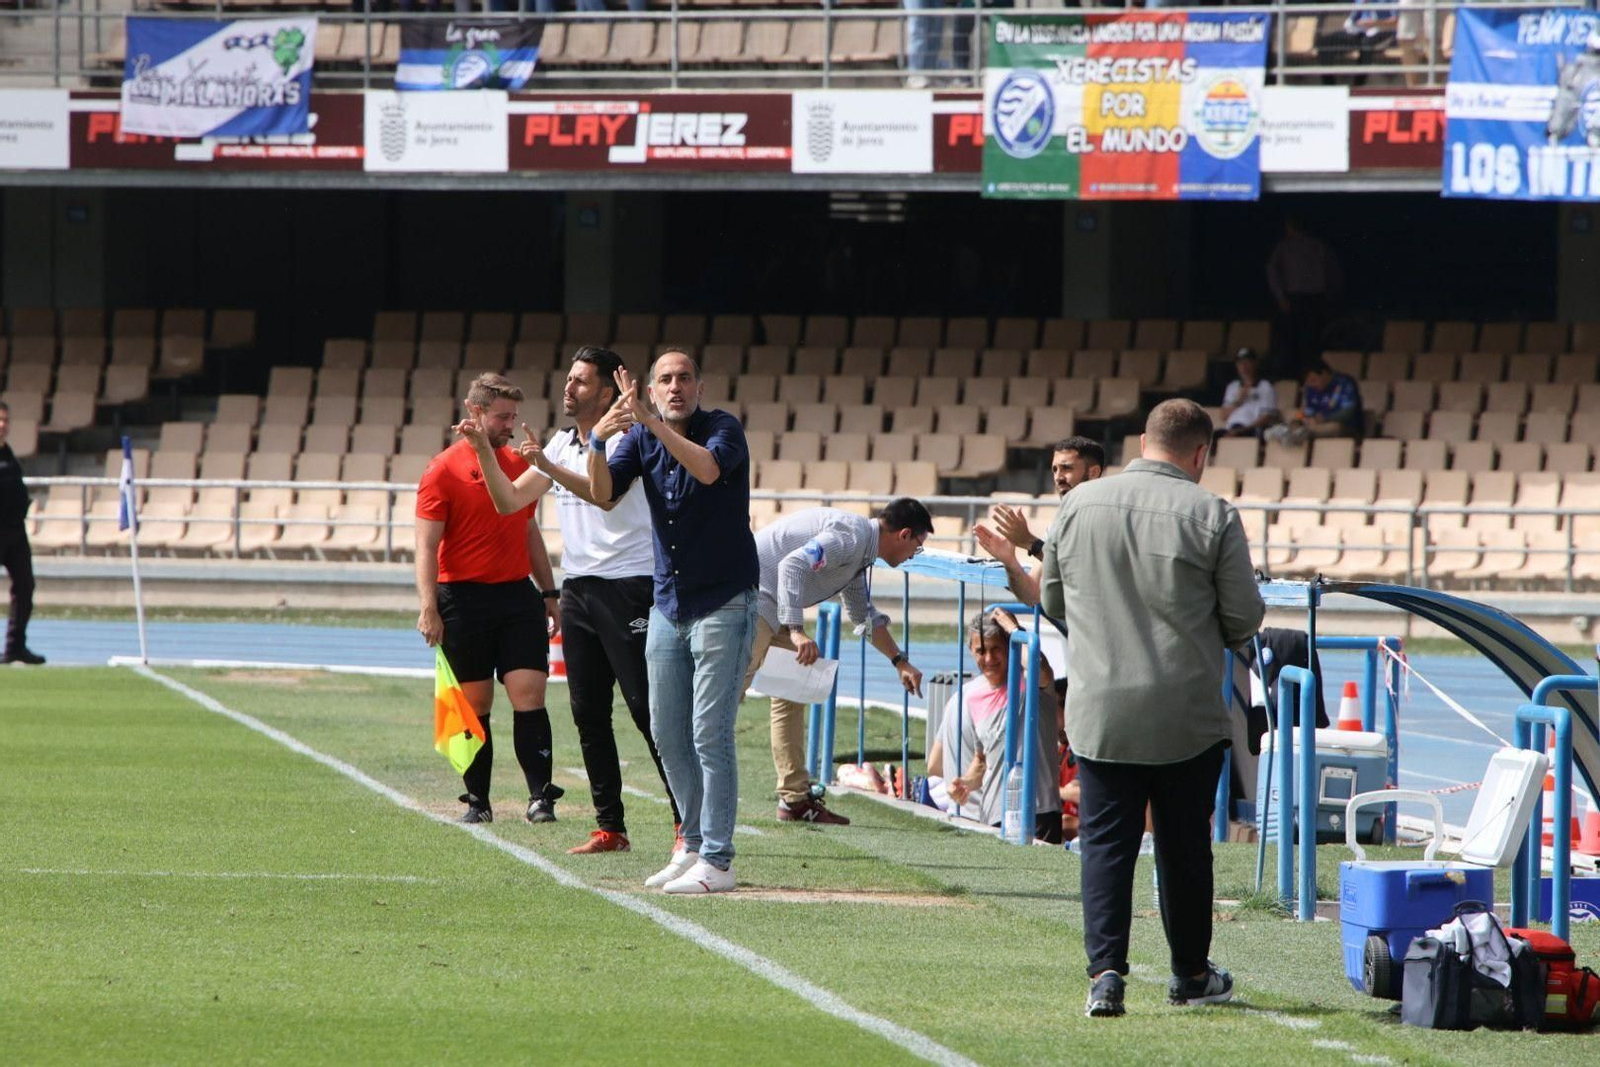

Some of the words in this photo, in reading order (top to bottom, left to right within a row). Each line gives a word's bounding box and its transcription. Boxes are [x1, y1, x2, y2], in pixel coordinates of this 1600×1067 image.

[1055, 56, 1197, 84] XERECISTAS
[1101, 91, 1146, 117] POR
[524, 114, 629, 146] PLAY
[1066, 126, 1095, 153] EL
[1101, 126, 1188, 153] MUNDO
[1451, 142, 1521, 194] LOS
